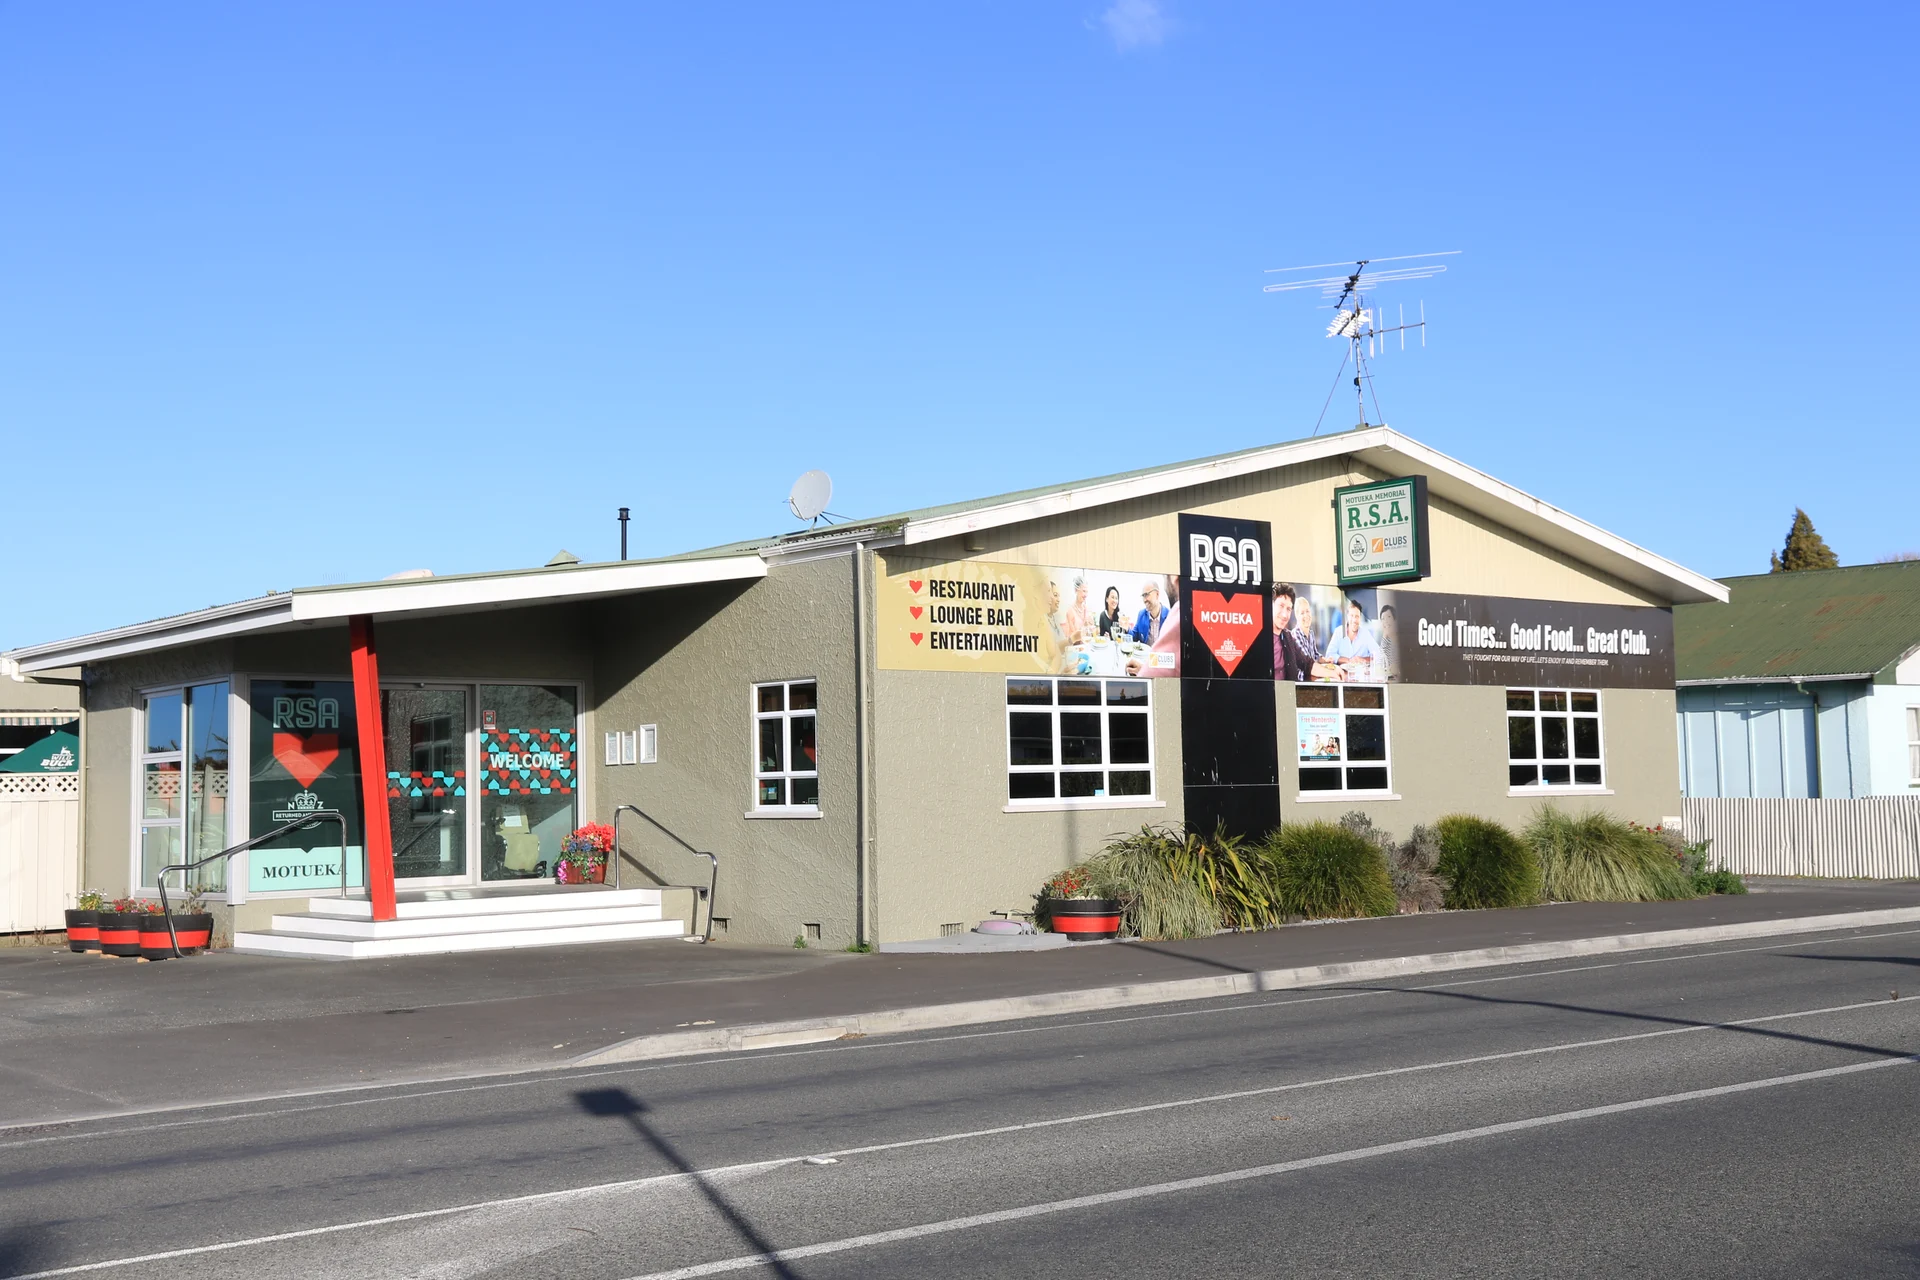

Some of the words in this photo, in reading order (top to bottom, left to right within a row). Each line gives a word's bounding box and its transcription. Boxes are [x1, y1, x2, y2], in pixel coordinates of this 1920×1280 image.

[1345, 495, 1373, 504] MOTUEKA
[1374, 490, 1406, 500] MEMORIAL
[1347, 501, 1409, 529] R.S.A.
[1384, 536, 1408, 547] CLUBS
[1190, 533, 1262, 586] RSA
[1370, 562, 1385, 570] MOST
[1385, 560, 1409, 568] WELCOME
[930, 580, 1015, 602] RESTAURANT
[930, 605, 983, 625] LOUNGE
[987, 608, 1014, 627] BAR
[1200, 611, 1254, 625] MOTUEKA
[930, 632, 1039, 653] ENTERTAINMENT
[1418, 617, 1453, 647] Good
[1455, 620, 1507, 649] Times...
[1510, 622, 1541, 651] Good
[1544, 625, 1584, 653] Food...
[1586, 627, 1619, 654] Great
[1620, 628, 1650, 655] Club.
[1463, 653, 1473, 661] THEY
[1474, 654, 1492, 662] FOUGHT
[1511, 655, 1521, 663] WAY
[1565, 657, 1575, 665] AND
[273, 697, 339, 728] RSA
[490, 753, 564, 768] WELCOME
[287, 802, 295, 810] N
[317, 801, 324, 809] Z
